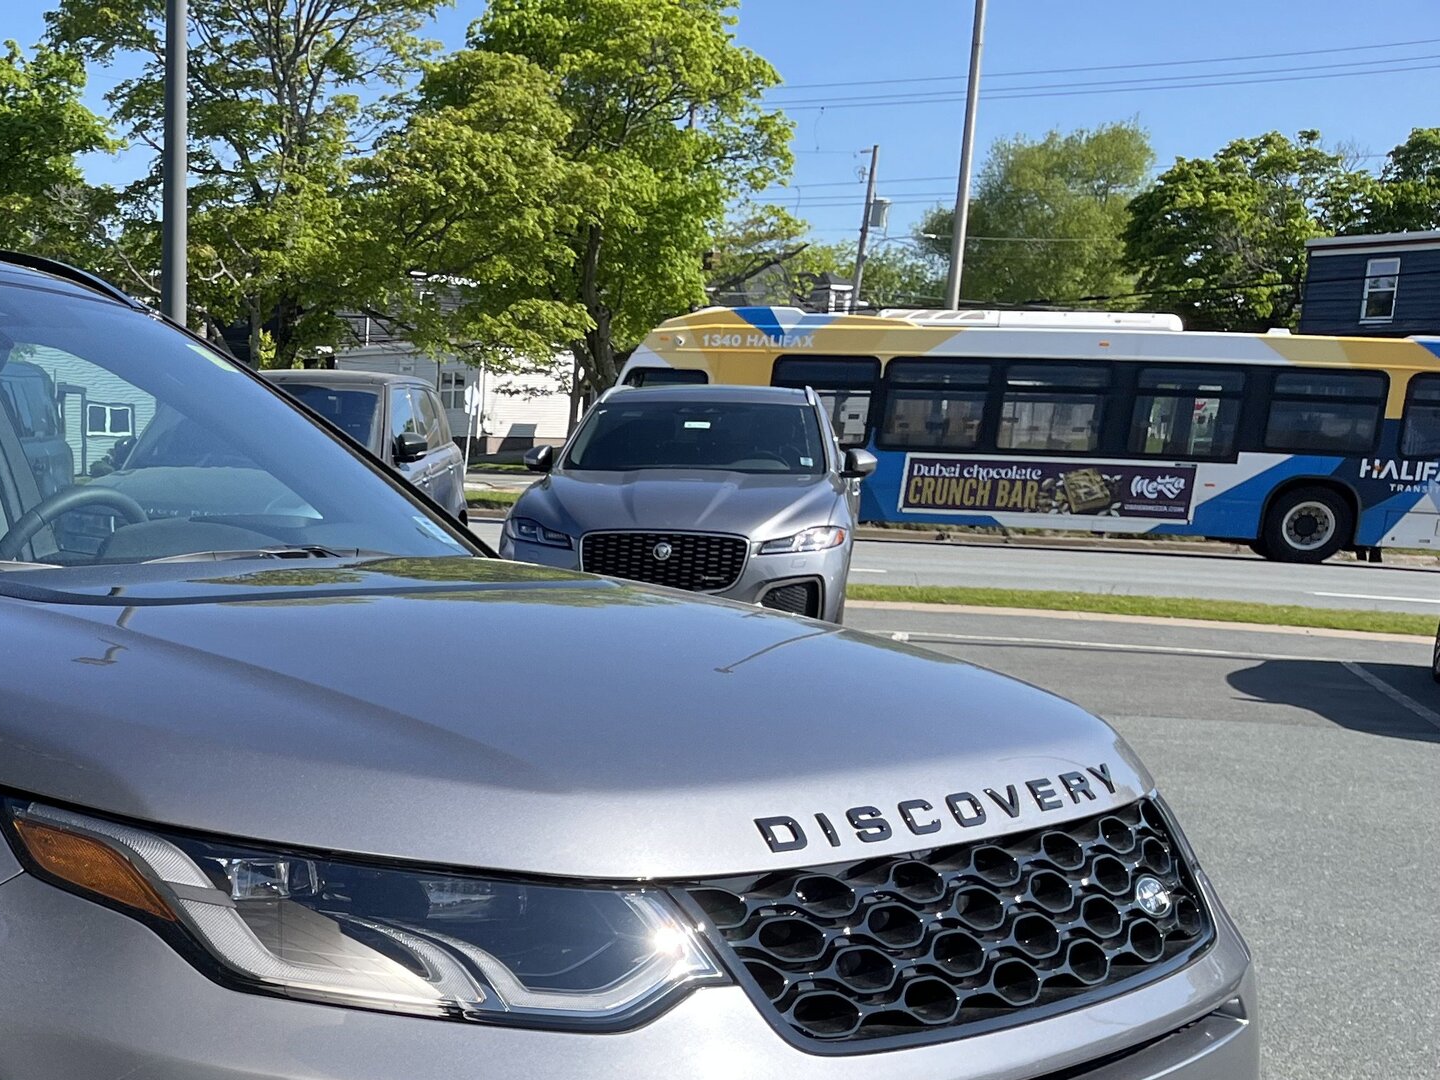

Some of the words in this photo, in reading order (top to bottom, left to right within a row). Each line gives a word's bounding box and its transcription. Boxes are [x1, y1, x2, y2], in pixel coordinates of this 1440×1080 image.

[702, 334, 742, 347] 1340
[746, 334, 815, 348] HALIFAX
[913, 462, 961, 477] Dubai
[963, 464, 1042, 481] chocolate
[908, 477, 992, 506] CRUNCH
[995, 479, 1039, 508] BAR
[753, 762, 1118, 853] DISCOVERY
